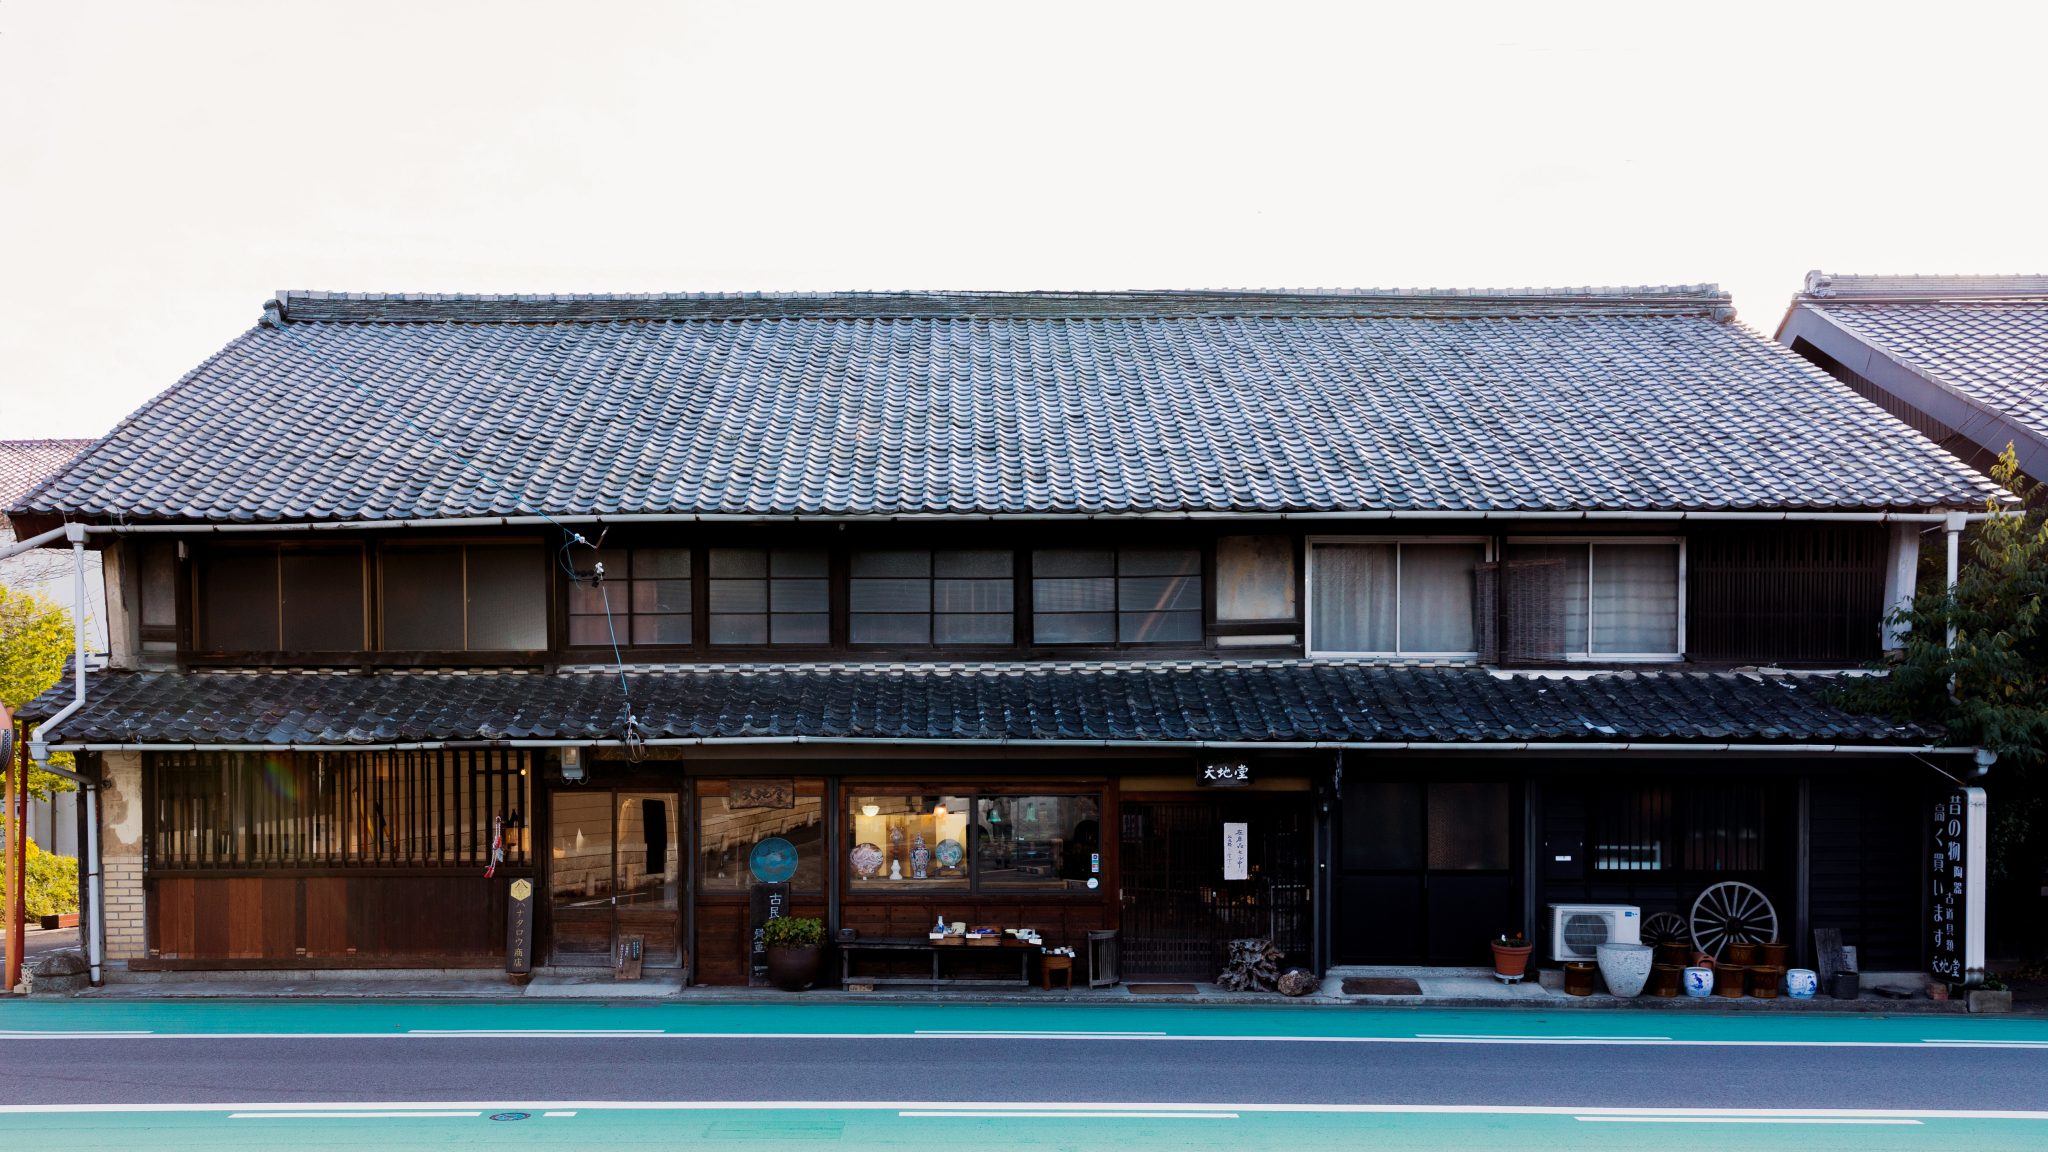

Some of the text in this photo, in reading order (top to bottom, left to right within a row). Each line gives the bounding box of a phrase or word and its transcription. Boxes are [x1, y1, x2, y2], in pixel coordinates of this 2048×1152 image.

[1203, 763, 1249, 780] 天地堂
[1947, 794, 1962, 862] 昔の物
[1933, 803, 1945, 947] 高く買います
[1953, 865, 1963, 895] 陶器
[513, 902, 526, 968] ハナタロウ商店
[1932, 955, 1961, 978] 天地堂
